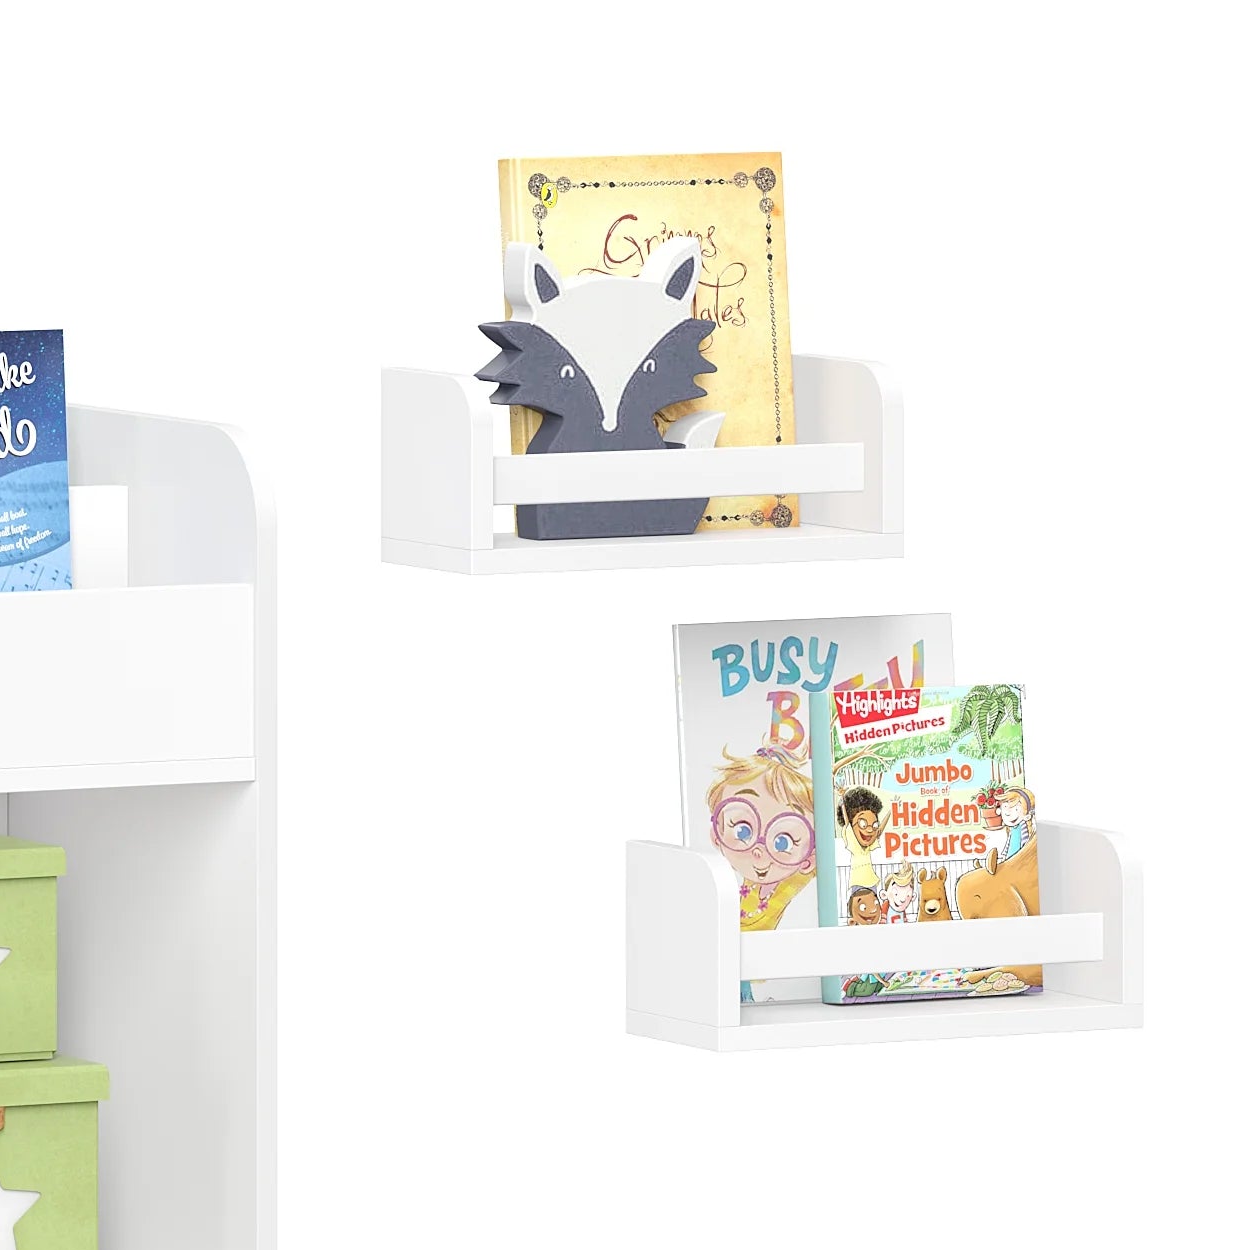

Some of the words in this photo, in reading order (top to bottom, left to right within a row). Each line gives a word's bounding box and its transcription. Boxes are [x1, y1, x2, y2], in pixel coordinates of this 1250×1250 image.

[16, 538, 24, 550] of
[712, 636, 839, 697] BUSY
[836, 689, 917, 718] Highlights
[844, 727, 891, 744] Hidden
[892, 716, 945, 735] Pictures
[895, 759, 972, 784] Jumbo
[920, 787, 938, 795] Book
[942, 786, 949, 794] of
[891, 799, 979, 827] Hidden
[885, 832, 987, 858] Pictures
